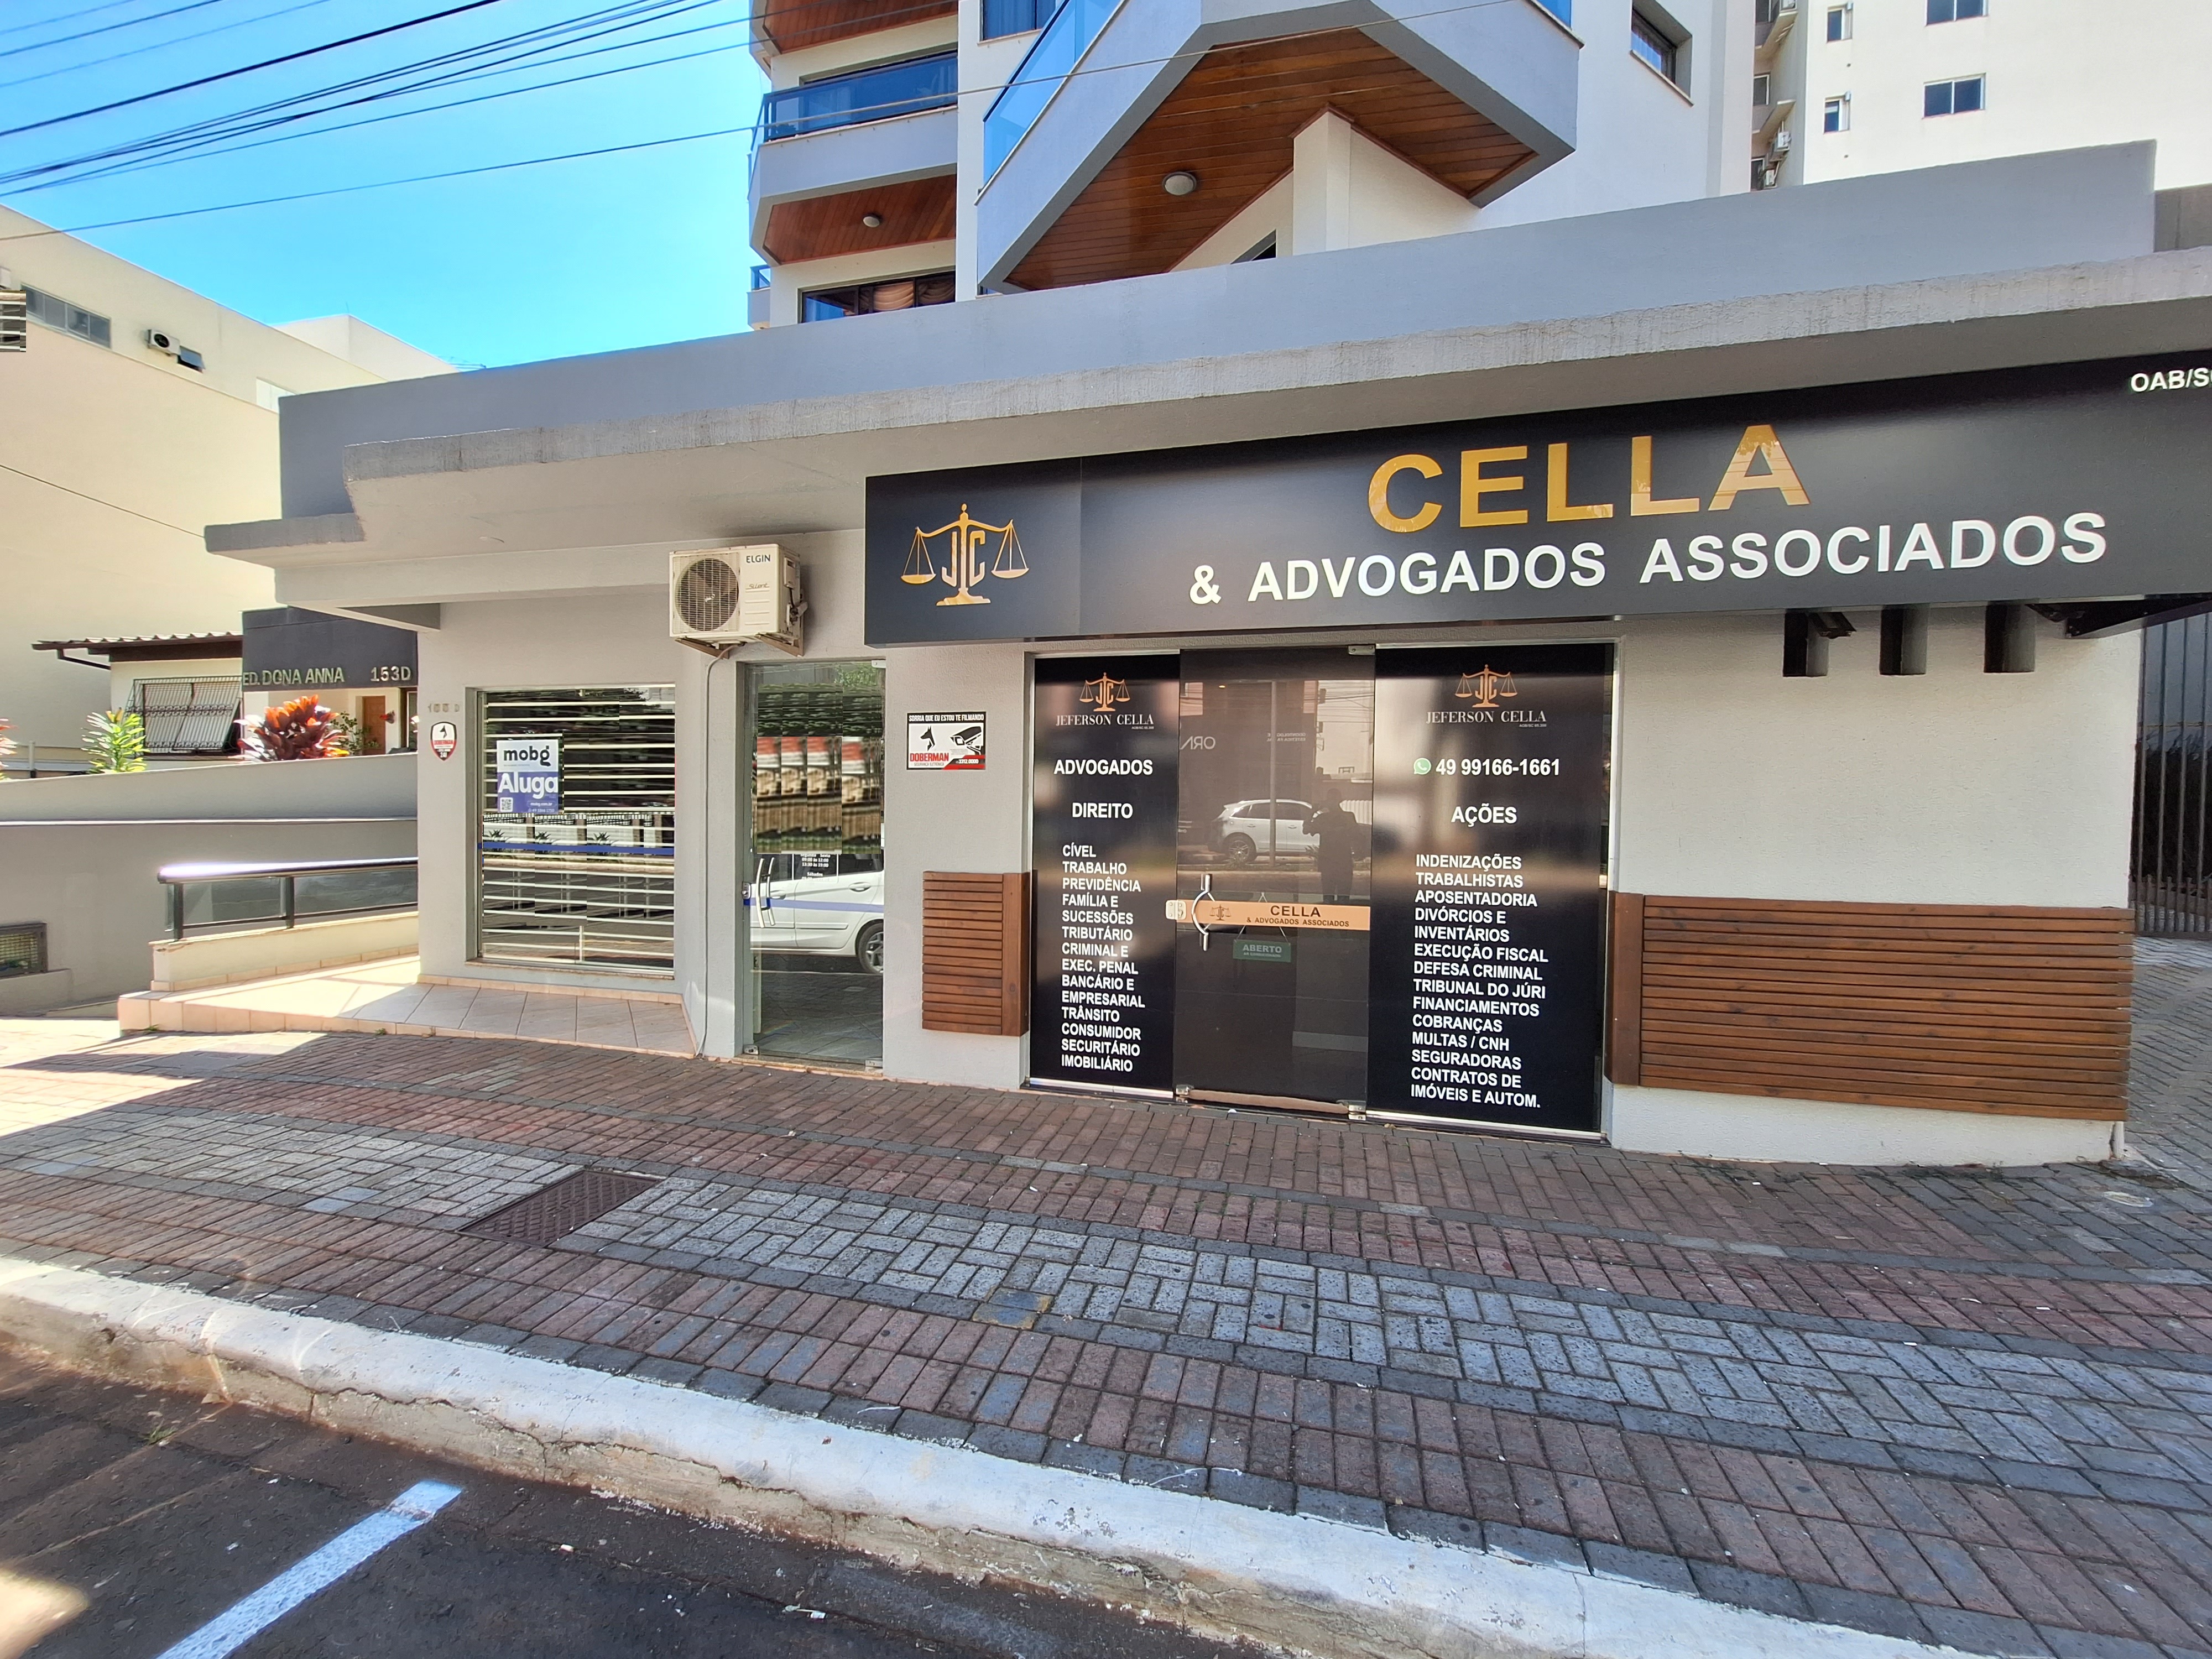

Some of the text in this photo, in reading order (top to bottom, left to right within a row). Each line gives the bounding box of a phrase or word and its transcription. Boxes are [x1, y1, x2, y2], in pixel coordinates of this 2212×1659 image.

[2131, 367, 2212, 392] OAB/S
[1368, 425, 1811, 533] CELLA
[746, 555, 770, 563] ELGIN
[1190, 512, 2106, 604] & ADVOGADOS ASSOCIADOS
[243, 666, 411, 686] ED. DONA ANNA 153D
[1056, 714, 1154, 726] JEFERSON CELLA
[1426, 710, 1546, 724] JEFERSON CELLA
[504, 745, 551, 767] mobg
[910, 753, 949, 761] DOBERMAN
[1053, 758, 1153, 776] ADVOGADOS
[1436, 758, 1560, 776] 49 99166-1661
[498, 771, 558, 799] Aluga
[1072, 802, 1133, 819] DIREITO
[1451, 802, 1517, 827] AÇÕES
[1063, 843, 1096, 857] CÍVEL
[1063, 861, 1127, 875] TRABALHO
[1416, 854, 1521, 872] INDENIZAÇÕES
[1063, 877, 1141, 892] PREVIDÊNCIA
[1416, 872, 1523, 888] TRABALHISTAS
[1062, 893, 1118, 907] FAMÍLIA E
[1415, 890, 1537, 907] APOSENTADORIA
[1062, 910, 1133, 925] SUCESSÕES
[1270, 905, 1321, 917] CELLA
[1415, 906, 1506, 924] DIVÓRCIOS E
[1302, 919, 1349, 927] ASSOCIADOS
[1062, 925, 1133, 941] TRIBUTÁRIO
[1415, 925, 1509, 942] INVENTÁRIOS
[1062, 942, 1128, 957] CRIMINAL E
[1243, 944, 1282, 953] ABERTO
[1414, 943, 1548, 962] EXECUÇÃO FISCAL
[1062, 959, 1138, 974] EXEC. PENAL
[1414, 961, 1543, 981] DEFESA CRIMINAL
[1062, 974, 1134, 990] BANCÁRIO E
[1413, 979, 1546, 999] TRIBUNAL DO JÚRI
[1062, 991, 1145, 1008] EMPRESARIAL
[1413, 997, 1540, 1016] FINANCIAMENTOS
[1062, 1006, 1120, 1022] TRÂNSITO
[1062, 1023, 1141, 1040] CONSUMIDOR
[1412, 1014, 1503, 1034] COBRANÇAS
[1062, 1039, 1140, 1056] SECURITÁRIO
[1412, 1032, 1509, 1051] MULTAS / CNH
[1062, 1054, 1133, 1072] IMOBILIÁRIO
[1412, 1050, 1521, 1070] SEGURADORAS
[1411, 1067, 1521, 1088] CONTRATOS DE
[1411, 1084, 1541, 1108] IMÓVEIS E AUTOM.
